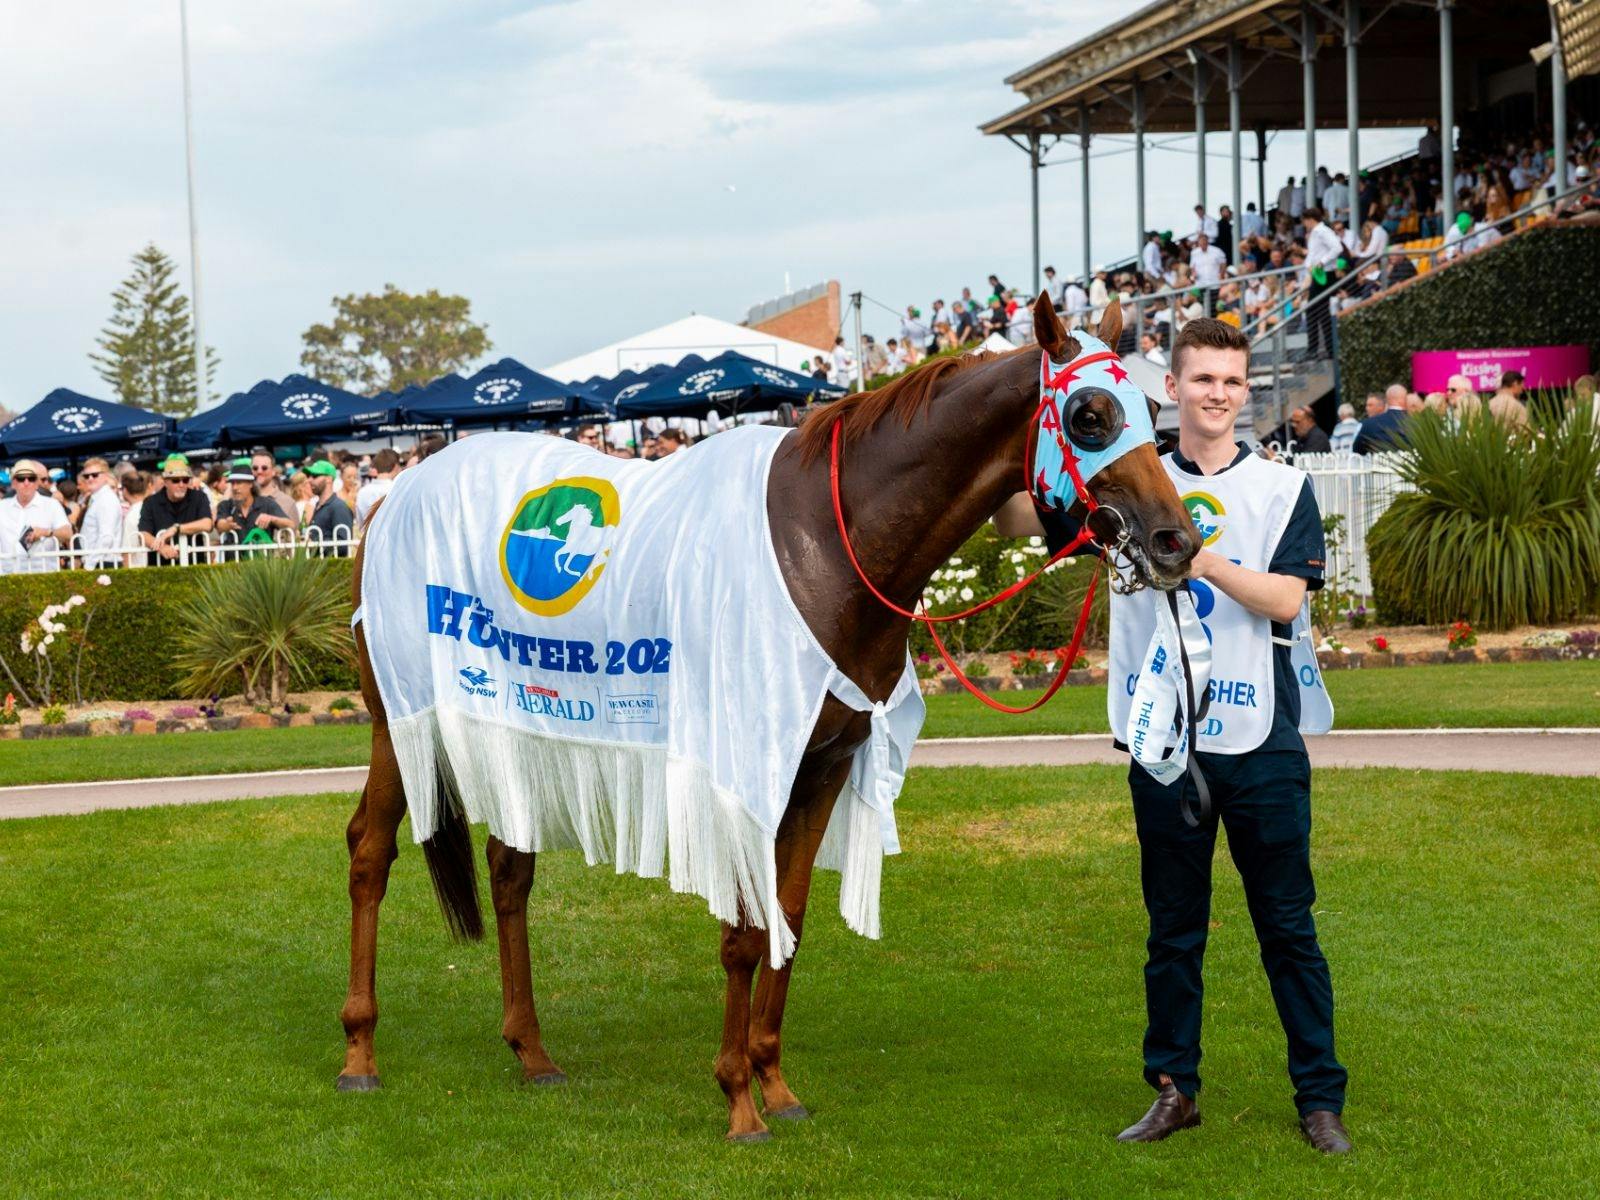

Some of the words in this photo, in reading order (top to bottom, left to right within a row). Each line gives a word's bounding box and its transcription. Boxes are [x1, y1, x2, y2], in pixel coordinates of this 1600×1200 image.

[426, 584, 598, 674] HUNTER
[476, 687, 498, 698] NSW
[511, 681, 595, 721] HERALD
[1138, 701, 1154, 728] THE
